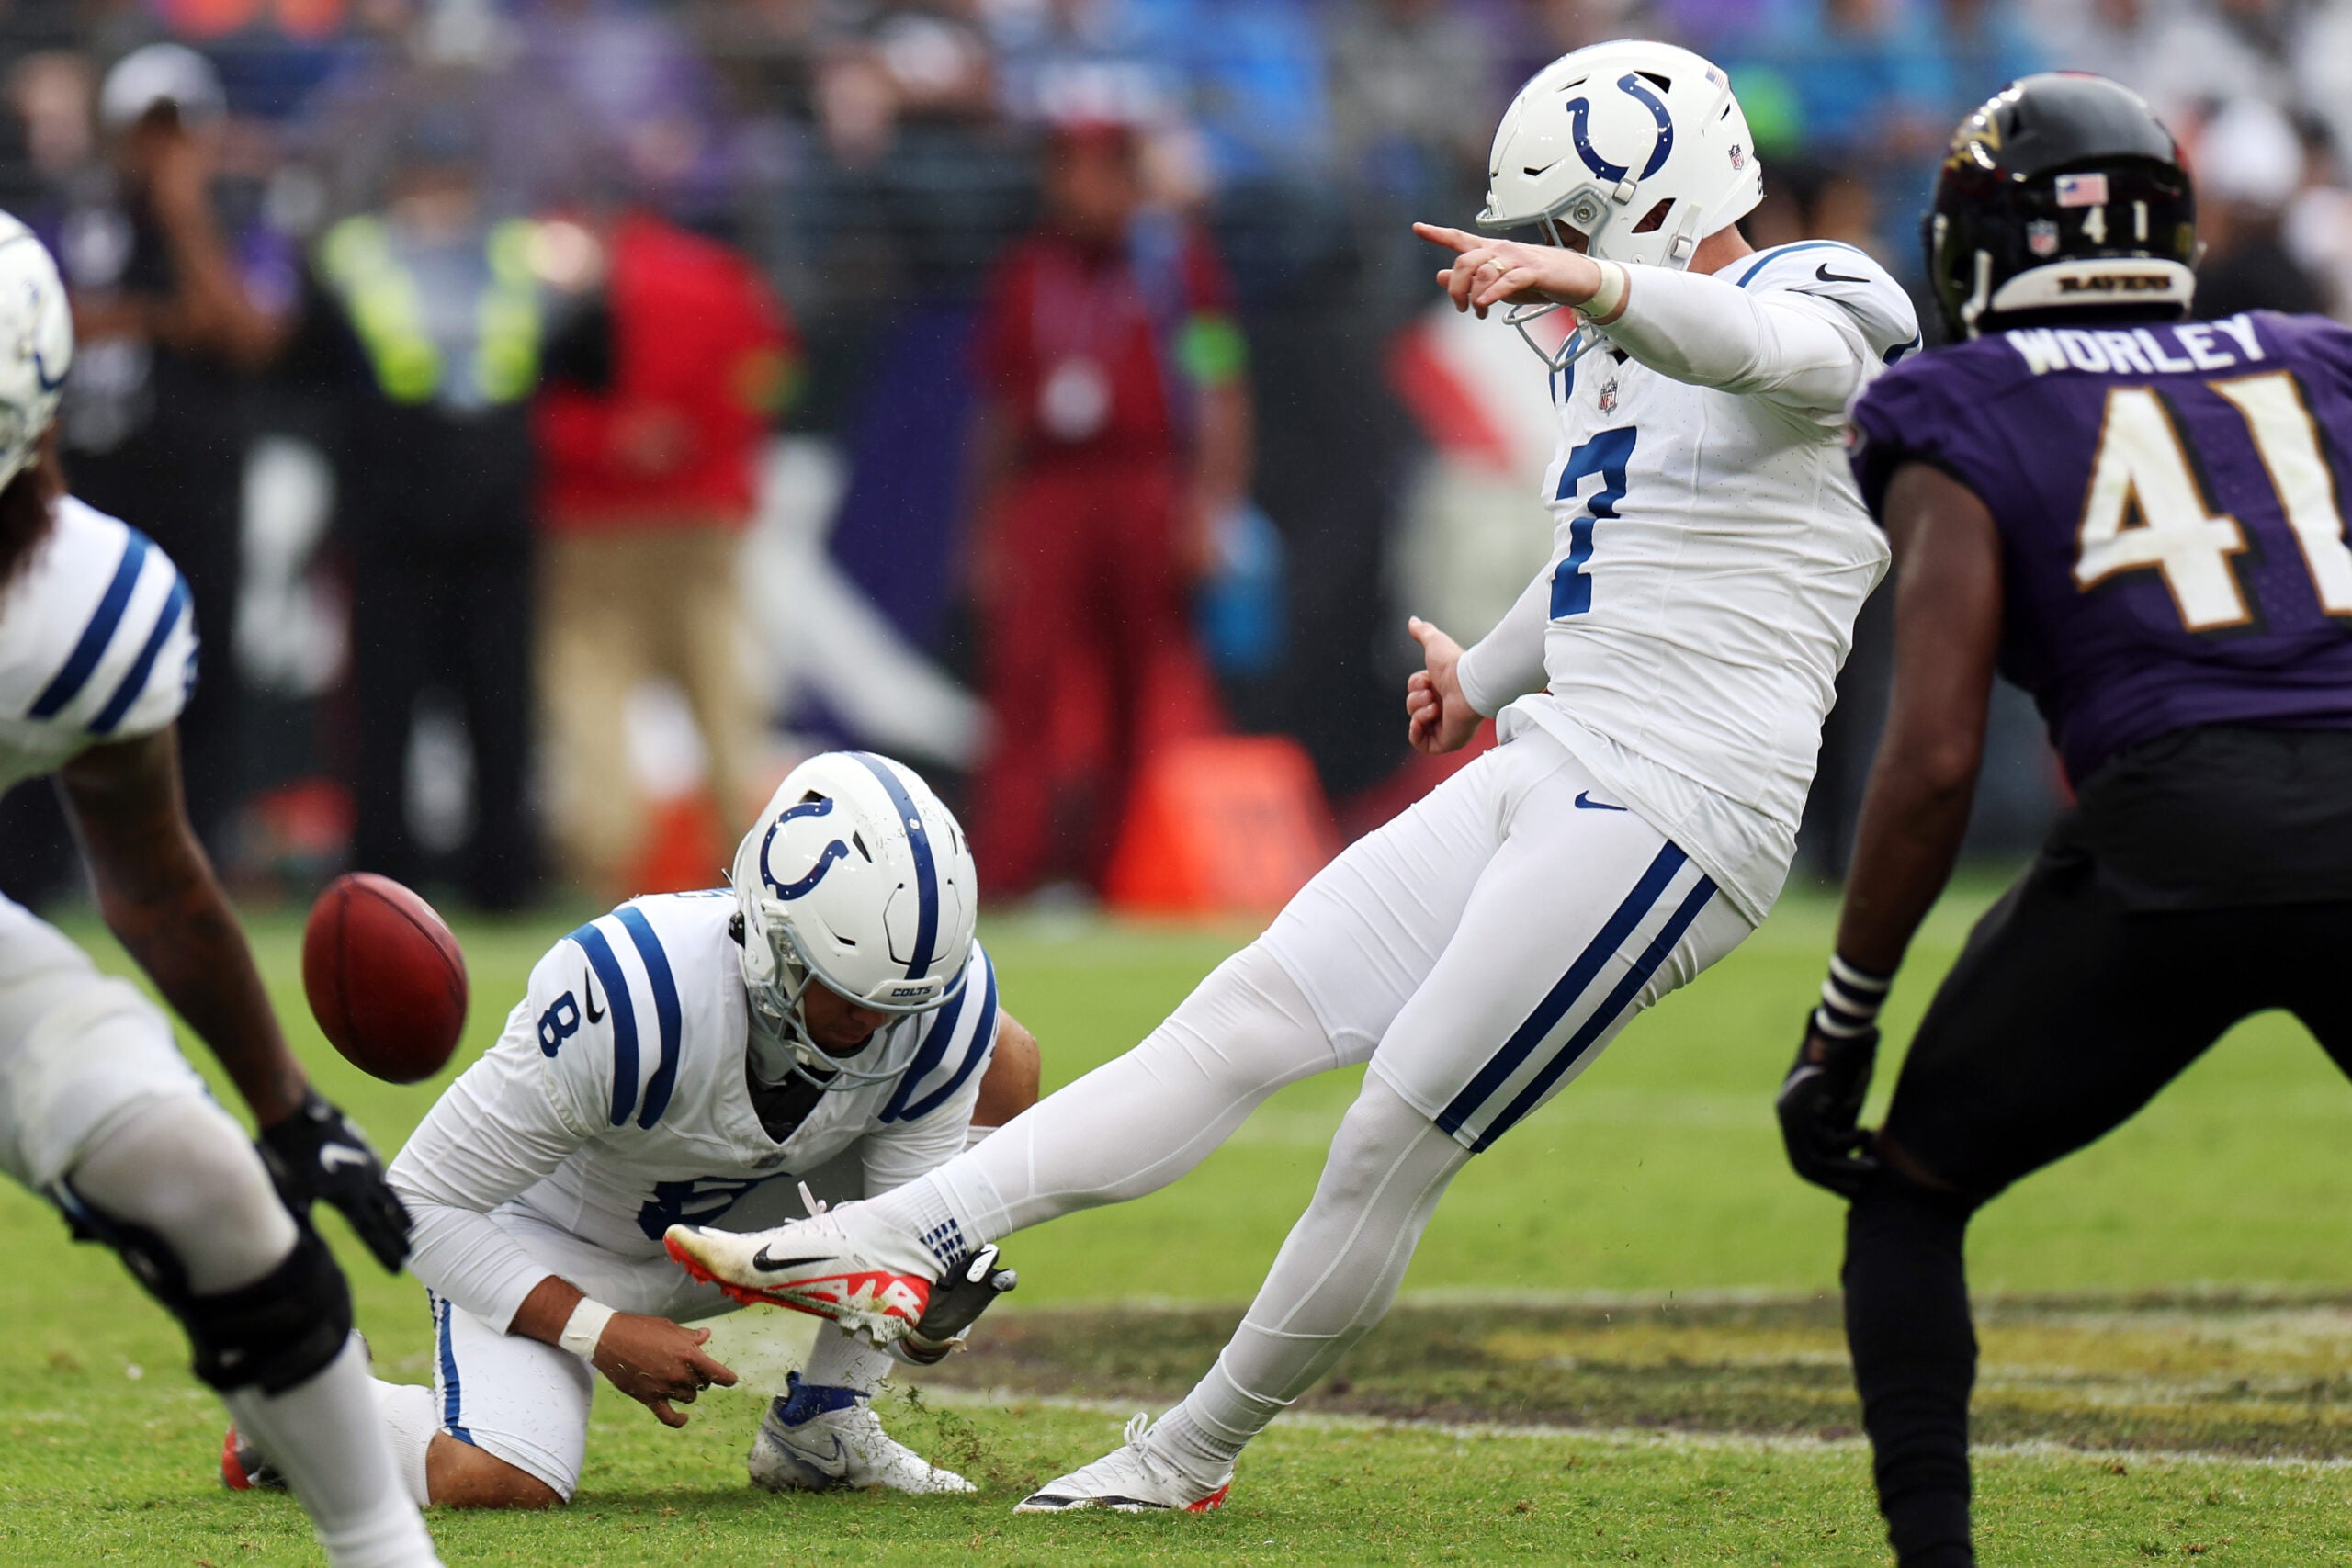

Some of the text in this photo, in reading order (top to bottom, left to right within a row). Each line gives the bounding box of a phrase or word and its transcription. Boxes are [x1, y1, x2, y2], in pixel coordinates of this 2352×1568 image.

[2005, 313, 2266, 375] WORLEY
[1550, 425, 1637, 620] 7
[2071, 368, 2352, 634] 41
[537, 990, 581, 1058] 8
[891, 986, 933, 997] COLTS
